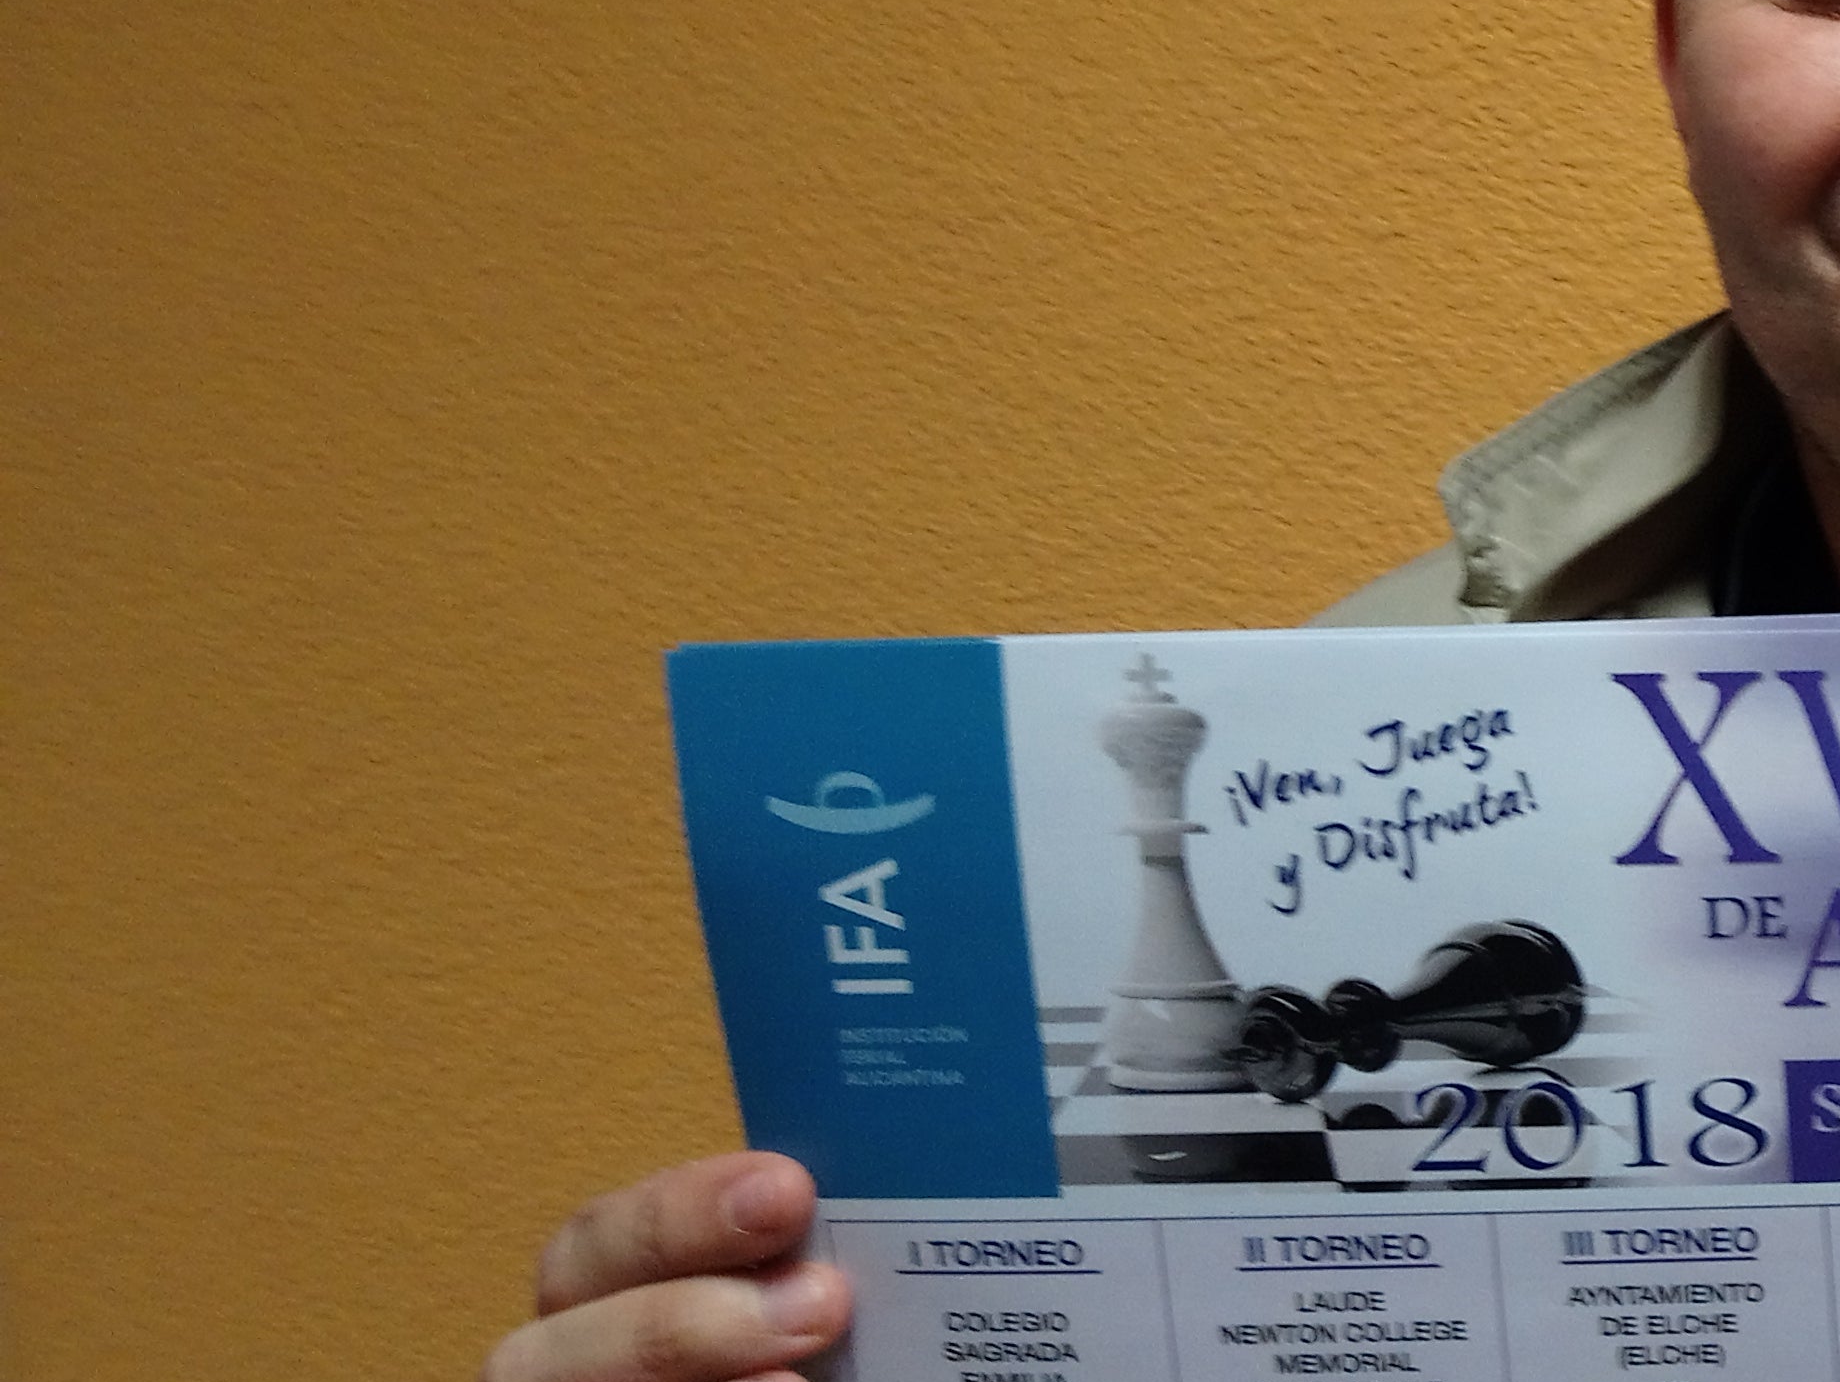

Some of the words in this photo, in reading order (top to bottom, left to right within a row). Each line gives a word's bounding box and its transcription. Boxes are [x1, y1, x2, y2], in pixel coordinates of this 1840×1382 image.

[1357, 705, 1512, 776] Juega
[1268, 855, 1302, 914] y
[1312, 771, 1537, 879] Disfruta!
[819, 859, 912, 995] IFA
[1702, 895, 1787, 941] DE
[1413, 1074, 1770, 1173] 2018
[930, 1239, 1083, 1267] TORNEO
[1244, 1239, 1265, 1261] II
[1274, 1235, 1430, 1261] TORNEO
[1563, 1232, 1594, 1257] III
[1603, 1227, 1758, 1256] TORNEO
[1293, 1292, 1386, 1312] LAUDE
[945, 1311, 1068, 1332] COLEGIO
[1220, 1324, 1337, 1345] NEWTON
[1347, 1321, 1467, 1341] COLLEGE
[1599, 1316, 1638, 1337] DE
[1647, 1314, 1739, 1335] ELCHE
[945, 1341, 1079, 1363] SAGRADA
[1274, 1353, 1419, 1373] MEMORIAL
[1621, 1344, 1726, 1369] (ELCHE)
